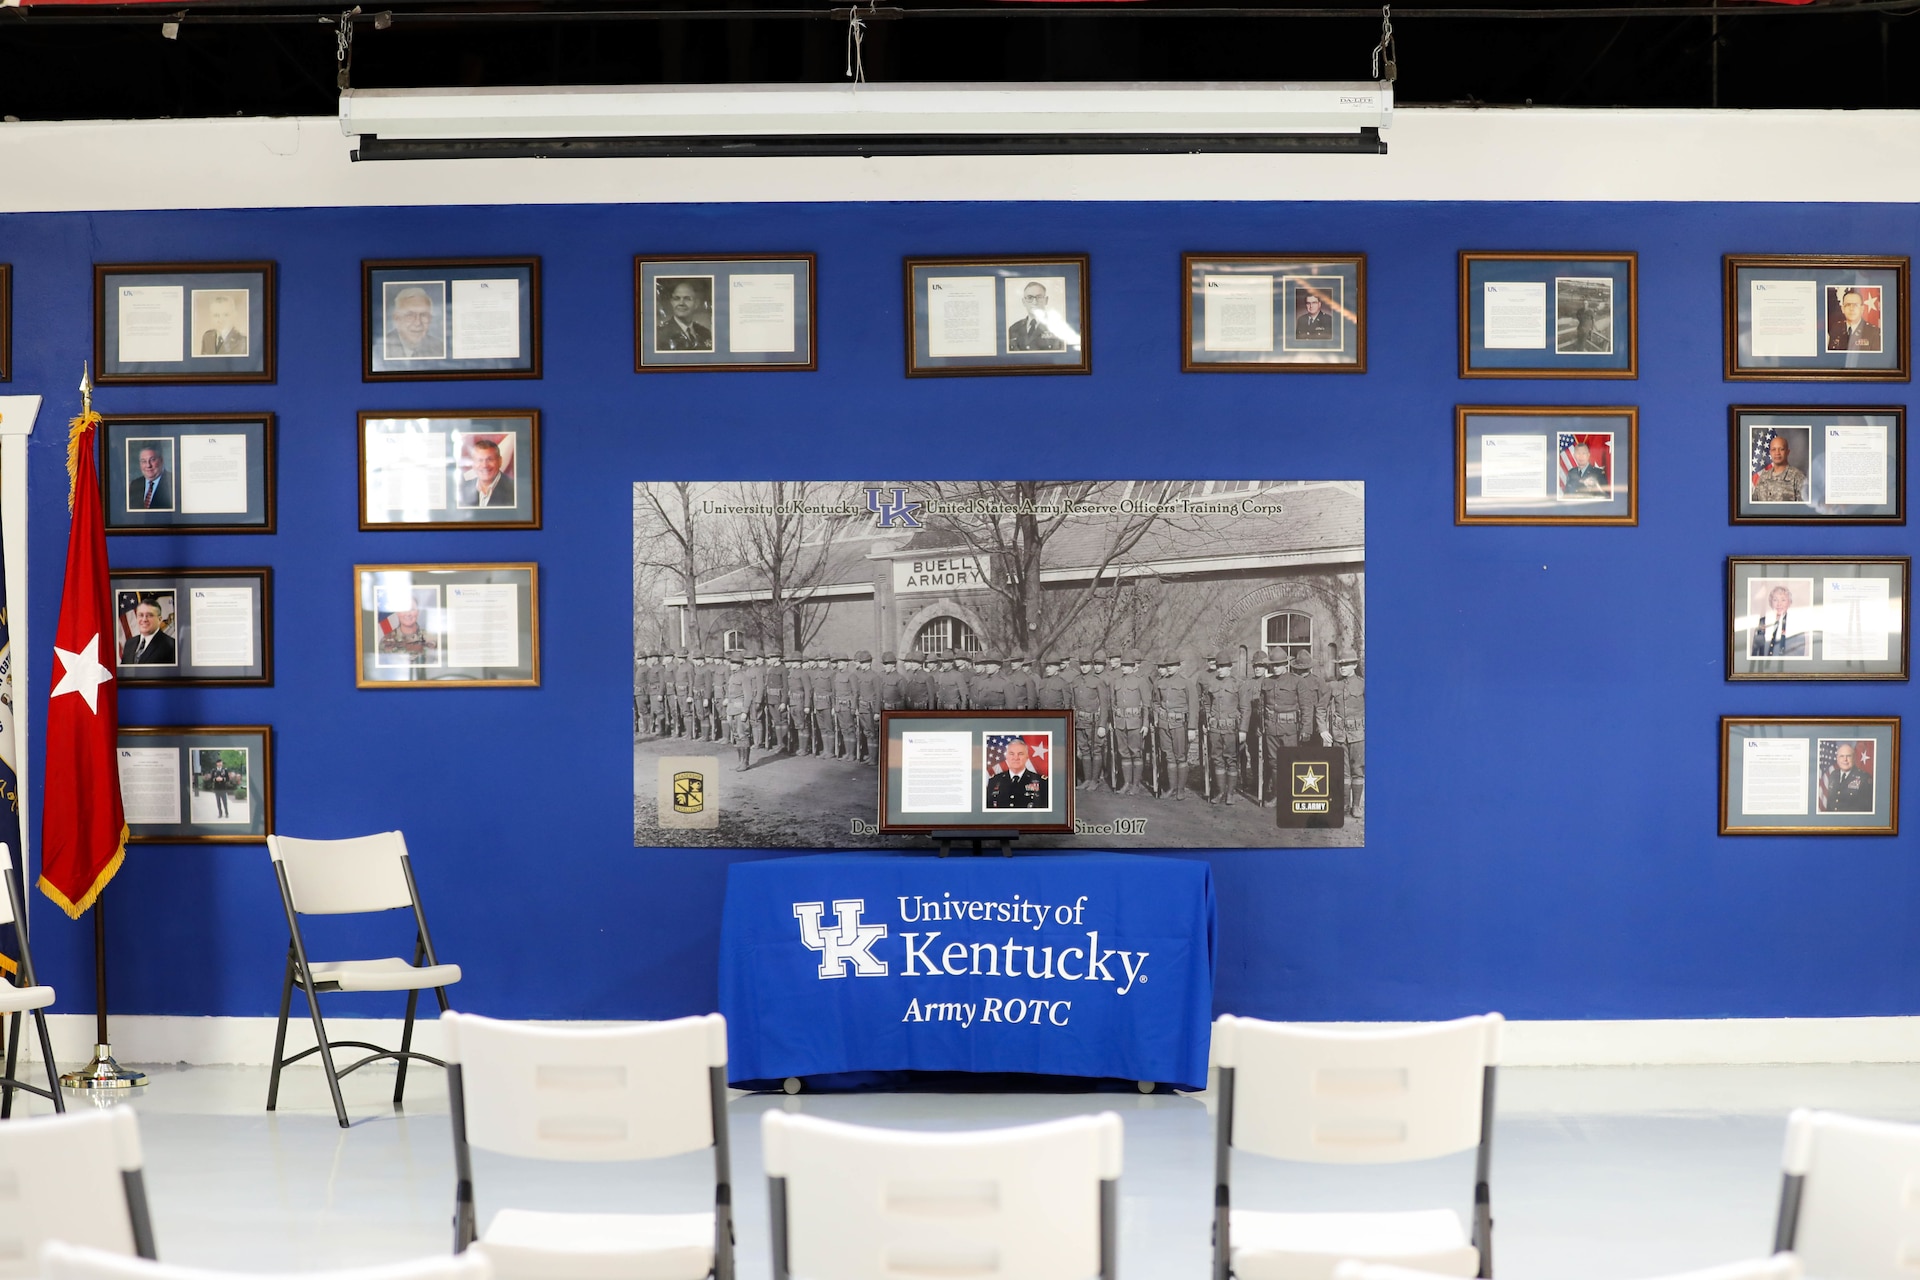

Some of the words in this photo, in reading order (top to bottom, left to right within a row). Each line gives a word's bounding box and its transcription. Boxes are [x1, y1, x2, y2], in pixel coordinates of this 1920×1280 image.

[702, 500, 773, 516] University
[776, 501, 790, 514] of
[792, 500, 859, 516] Kentucky
[863, 488, 922, 527] UK
[926, 500, 974, 514] United
[976, 499, 1018, 514] States
[1063, 499, 1118, 514] Reserve
[1181, 499, 1239, 516] Training
[1241, 499, 1282, 516] Corps
[906, 571, 981, 587] ARMORY
[913, 558, 972, 573] BUELL
[1075, 819, 1112, 834] Since
[1114, 819, 1146, 834] 1917
[897, 892, 1052, 931] University
[1054, 895, 1089, 926] of
[792, 899, 888, 980] UK
[902, 997, 977, 1029] Army
[981, 997, 1072, 1027] ROTC
